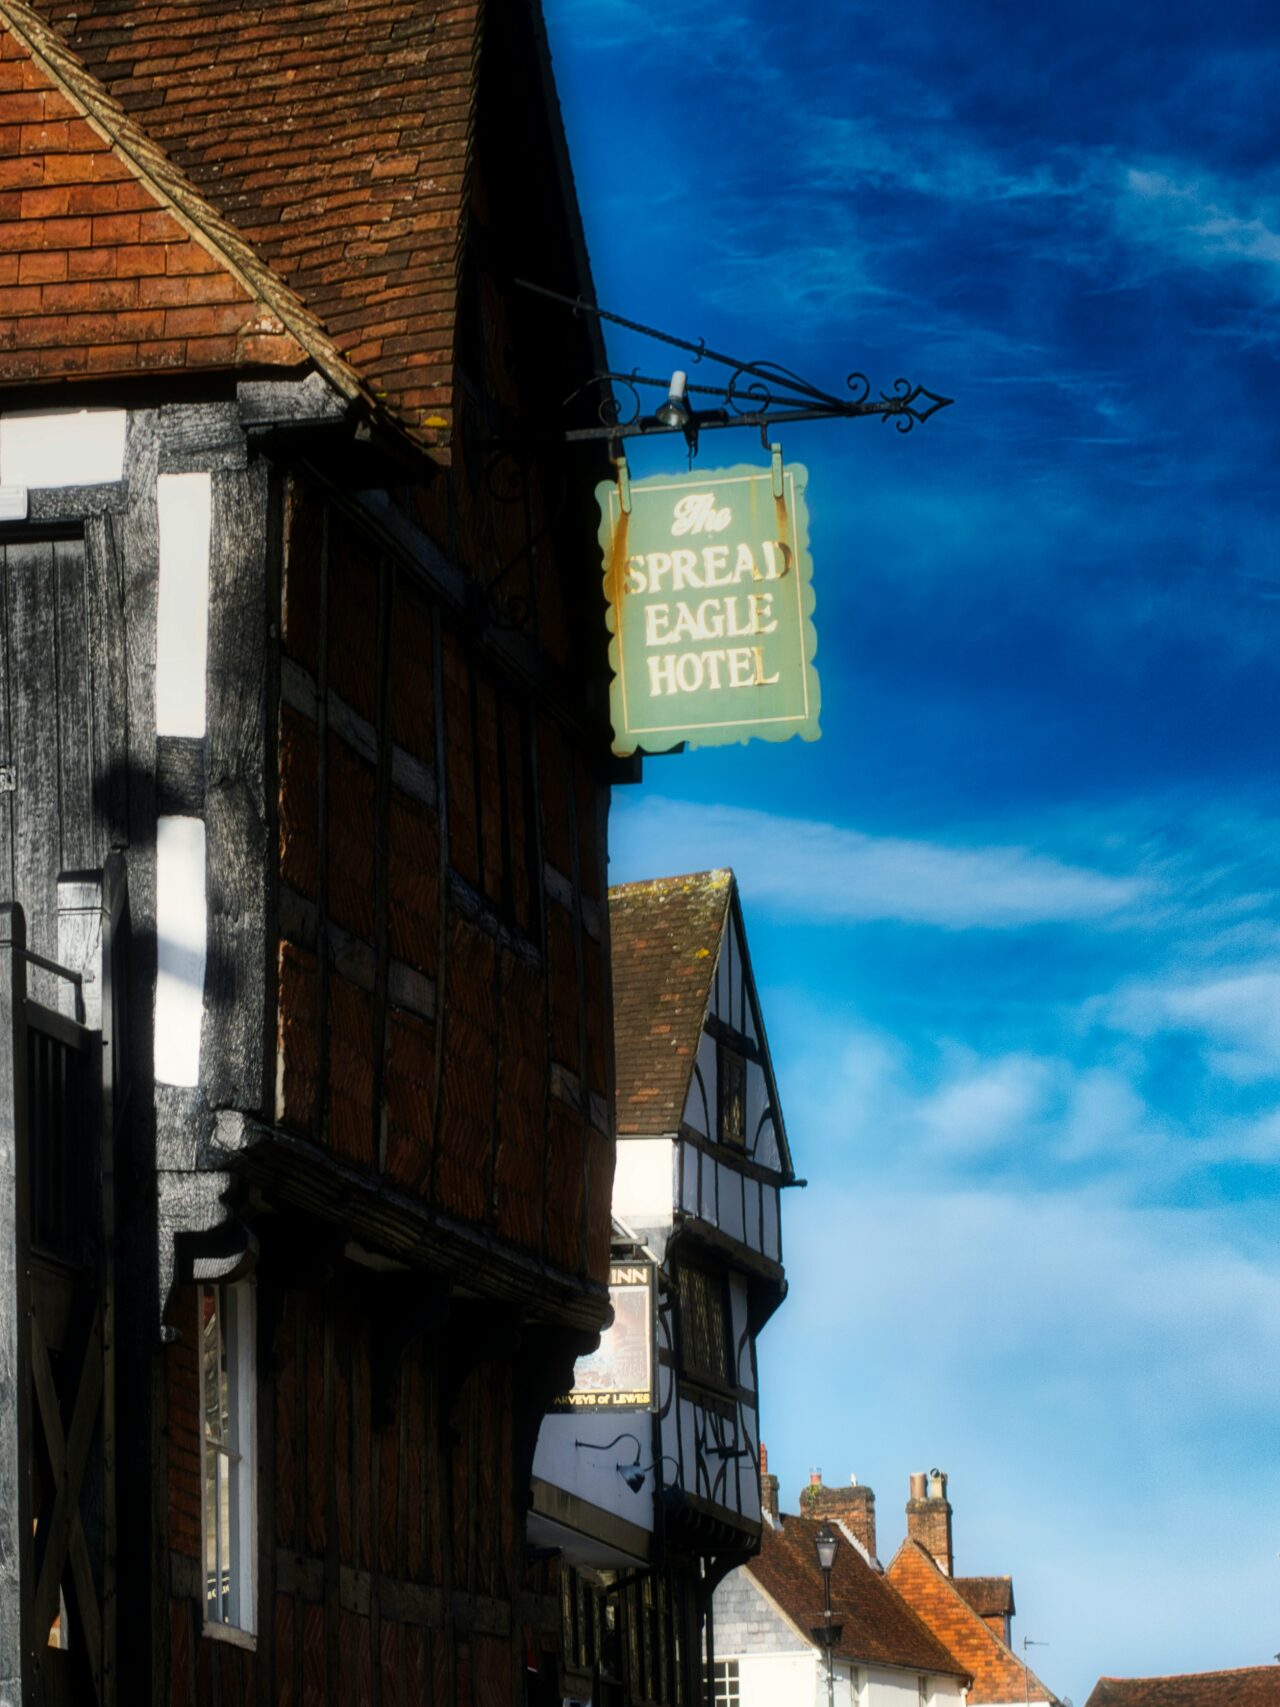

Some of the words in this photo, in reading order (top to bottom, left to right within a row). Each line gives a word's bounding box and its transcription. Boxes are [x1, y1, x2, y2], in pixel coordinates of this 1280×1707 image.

[671, 493, 732, 536] The
[624, 541, 792, 594] SPREAD
[645, 593, 778, 646] EAGLE
[647, 646, 780, 697] HOTEL
[611, 1268, 648, 1284] INN
[597, 1393, 610, 1404] of
[613, 1392, 650, 1404] LEWES
